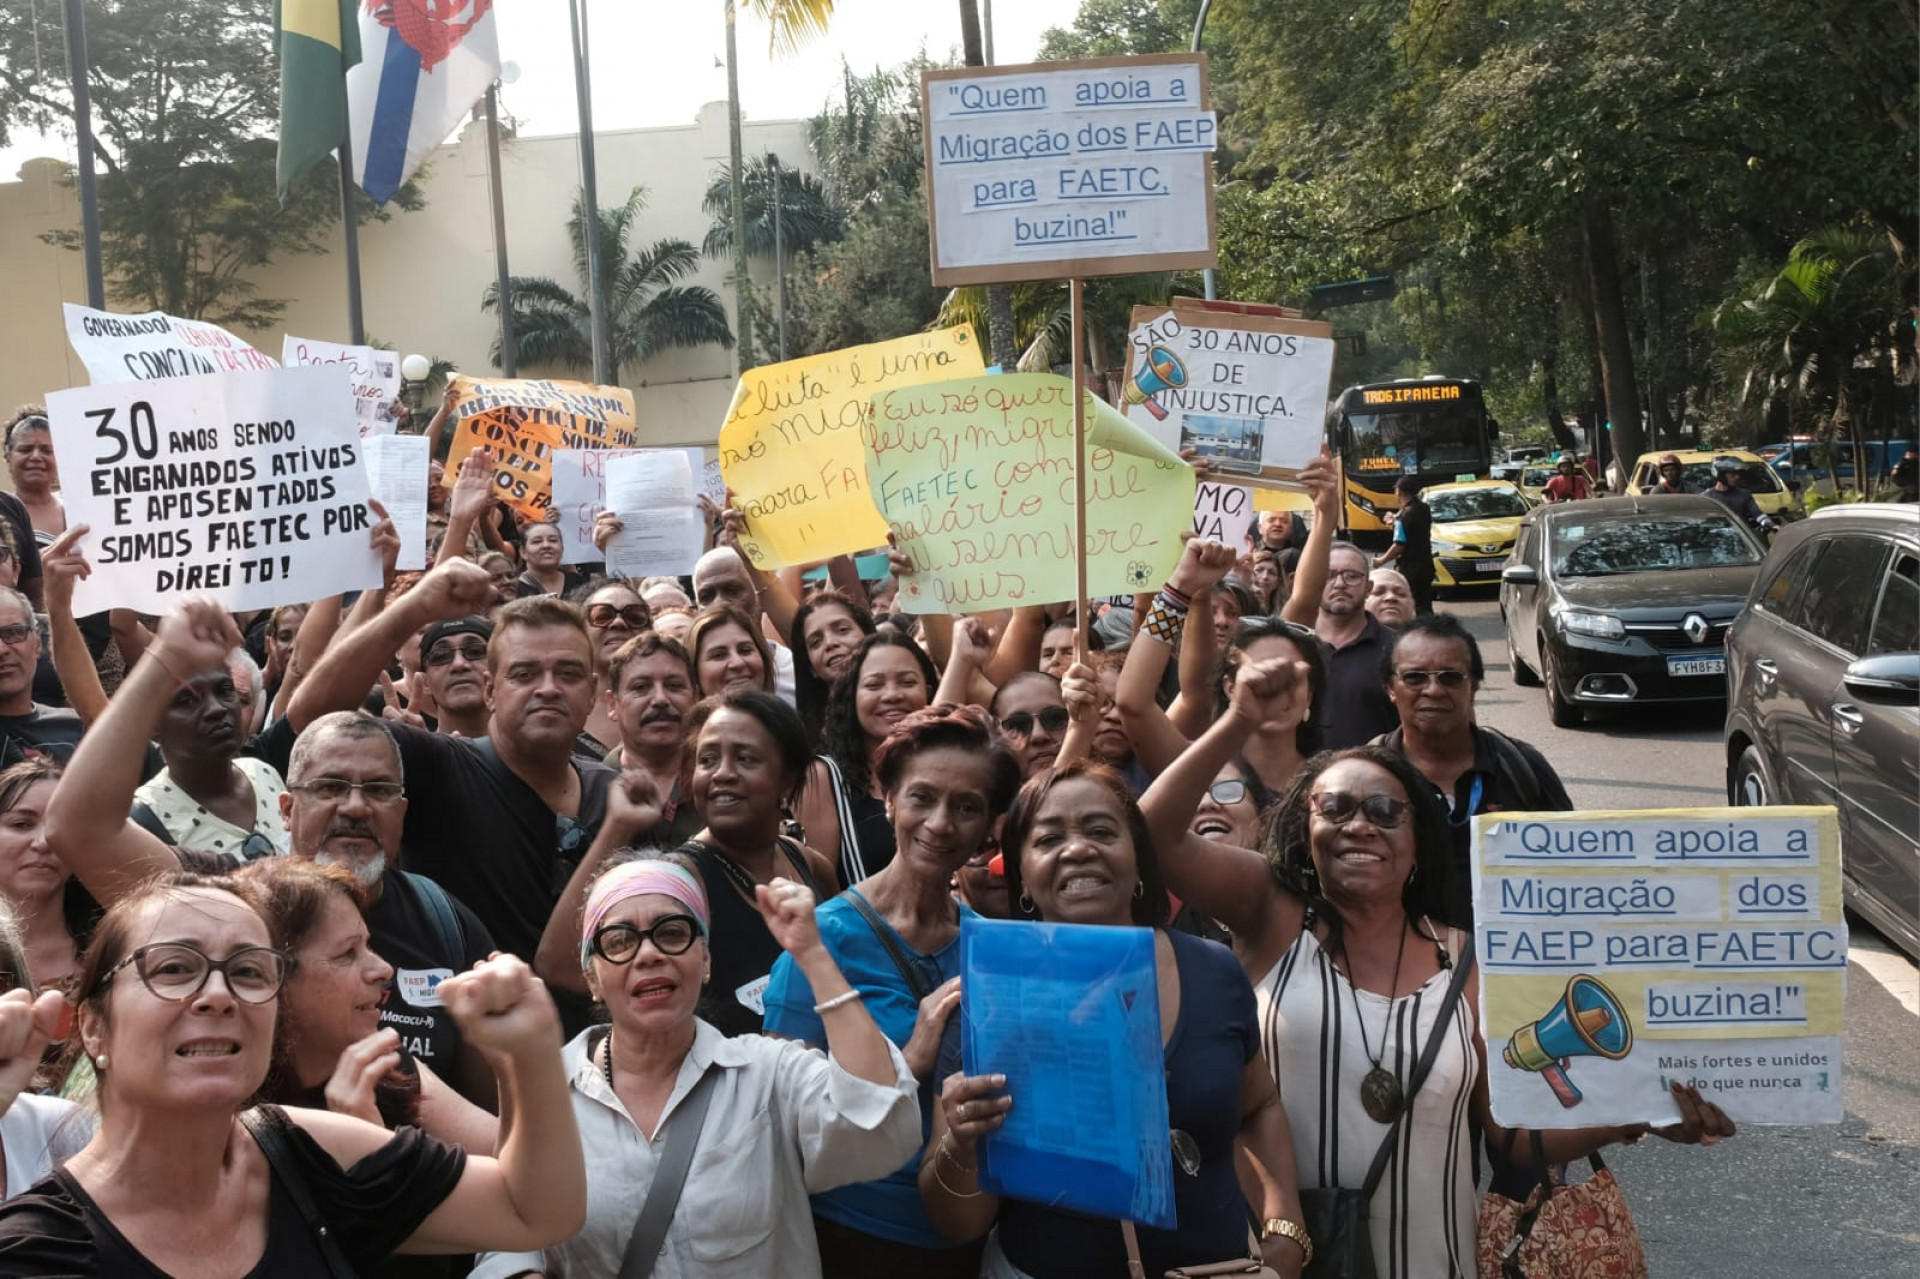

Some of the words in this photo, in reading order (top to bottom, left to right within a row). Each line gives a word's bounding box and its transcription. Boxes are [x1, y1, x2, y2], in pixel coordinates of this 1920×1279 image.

[949, 84, 1046, 109] "Quem
[1075, 75, 1150, 104] apoia
[1170, 78, 1185, 98] a
[940, 129, 1070, 162] Migração
[1077, 123, 1127, 147] dos
[1135, 118, 1215, 146] FAEP
[973, 177, 1036, 206] para
[1015, 210, 1126, 241] buzina!"
[1133, 317, 1181, 355] SÃO
[1189, 329, 1218, 350] 30
[1226, 332, 1297, 356] ANOS
[1213, 363, 1244, 384] DE
[1162, 389, 1294, 418] INJUSTIÇA.
[1395, 385, 1460, 402] IPANEMA
[85, 401, 158, 466] 30
[169, 427, 218, 454] ANOS
[234, 419, 296, 446] SENDO
[91, 456, 257, 497] ENGANADOS
[271, 443, 356, 477] ATIVOS
[820, 458, 869, 499] FA
[114, 499, 132, 526] E
[147, 475, 337, 523] APOSENTADOS
[98, 529, 193, 565] SOMOS
[207, 513, 311, 553] FAETEC
[323, 504, 371, 535] POR
[156, 555, 291, 593] DIREITO!
[1505, 822, 1634, 854] "Quem
[1656, 823, 1759, 858] apoia
[1787, 828, 1808, 853] a
[1501, 877, 1675, 917] Migração
[1738, 877, 1807, 906] dos
[1486, 930, 1593, 961] FAEP
[1605, 933, 1688, 965] para
[1696, 930, 1847, 966] FAETC,
[1648, 986, 1799, 1019] buzina!"
[1658, 1056, 1698, 1069] Mais
[1703, 1055, 1752, 1068] fortes
[1757, 1057, 1767, 1067] e
[1772, 1053, 1828, 1067] unidos
[1713, 1079, 1744, 1093] que
